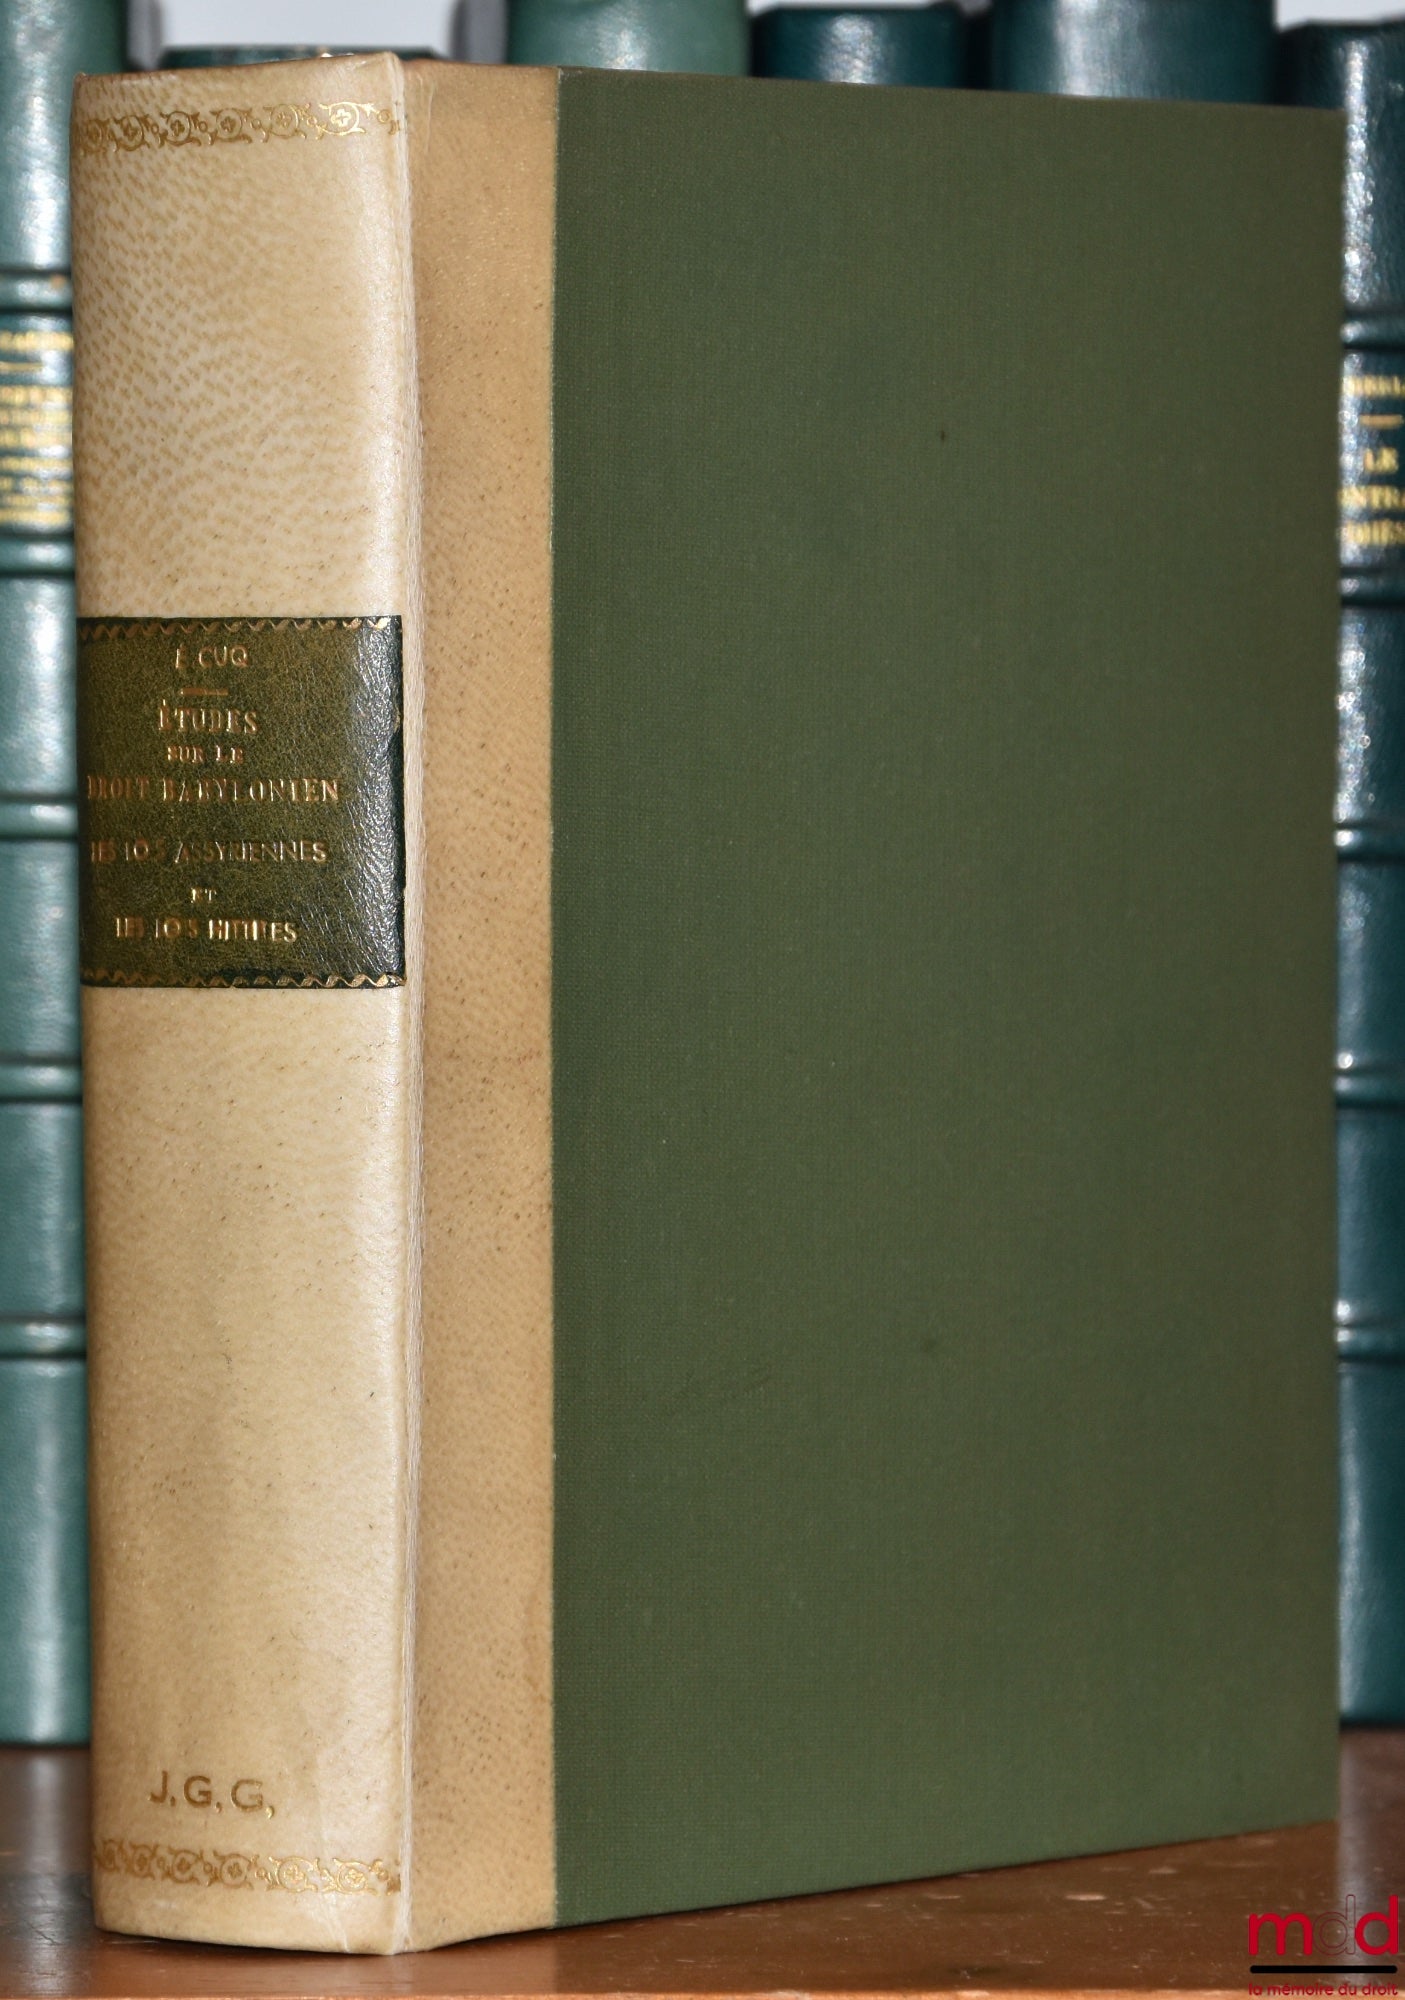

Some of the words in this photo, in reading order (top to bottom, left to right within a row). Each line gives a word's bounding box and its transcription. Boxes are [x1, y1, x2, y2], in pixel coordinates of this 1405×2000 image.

[198, 644, 248, 668] CUQ
[158, 699, 258, 735] ÉTUDES
[166, 744, 205, 763] SUR
[215, 745, 244, 764] LE
[87, 774, 149, 801] DROIT
[162, 777, 340, 804] BABYLONIEN
